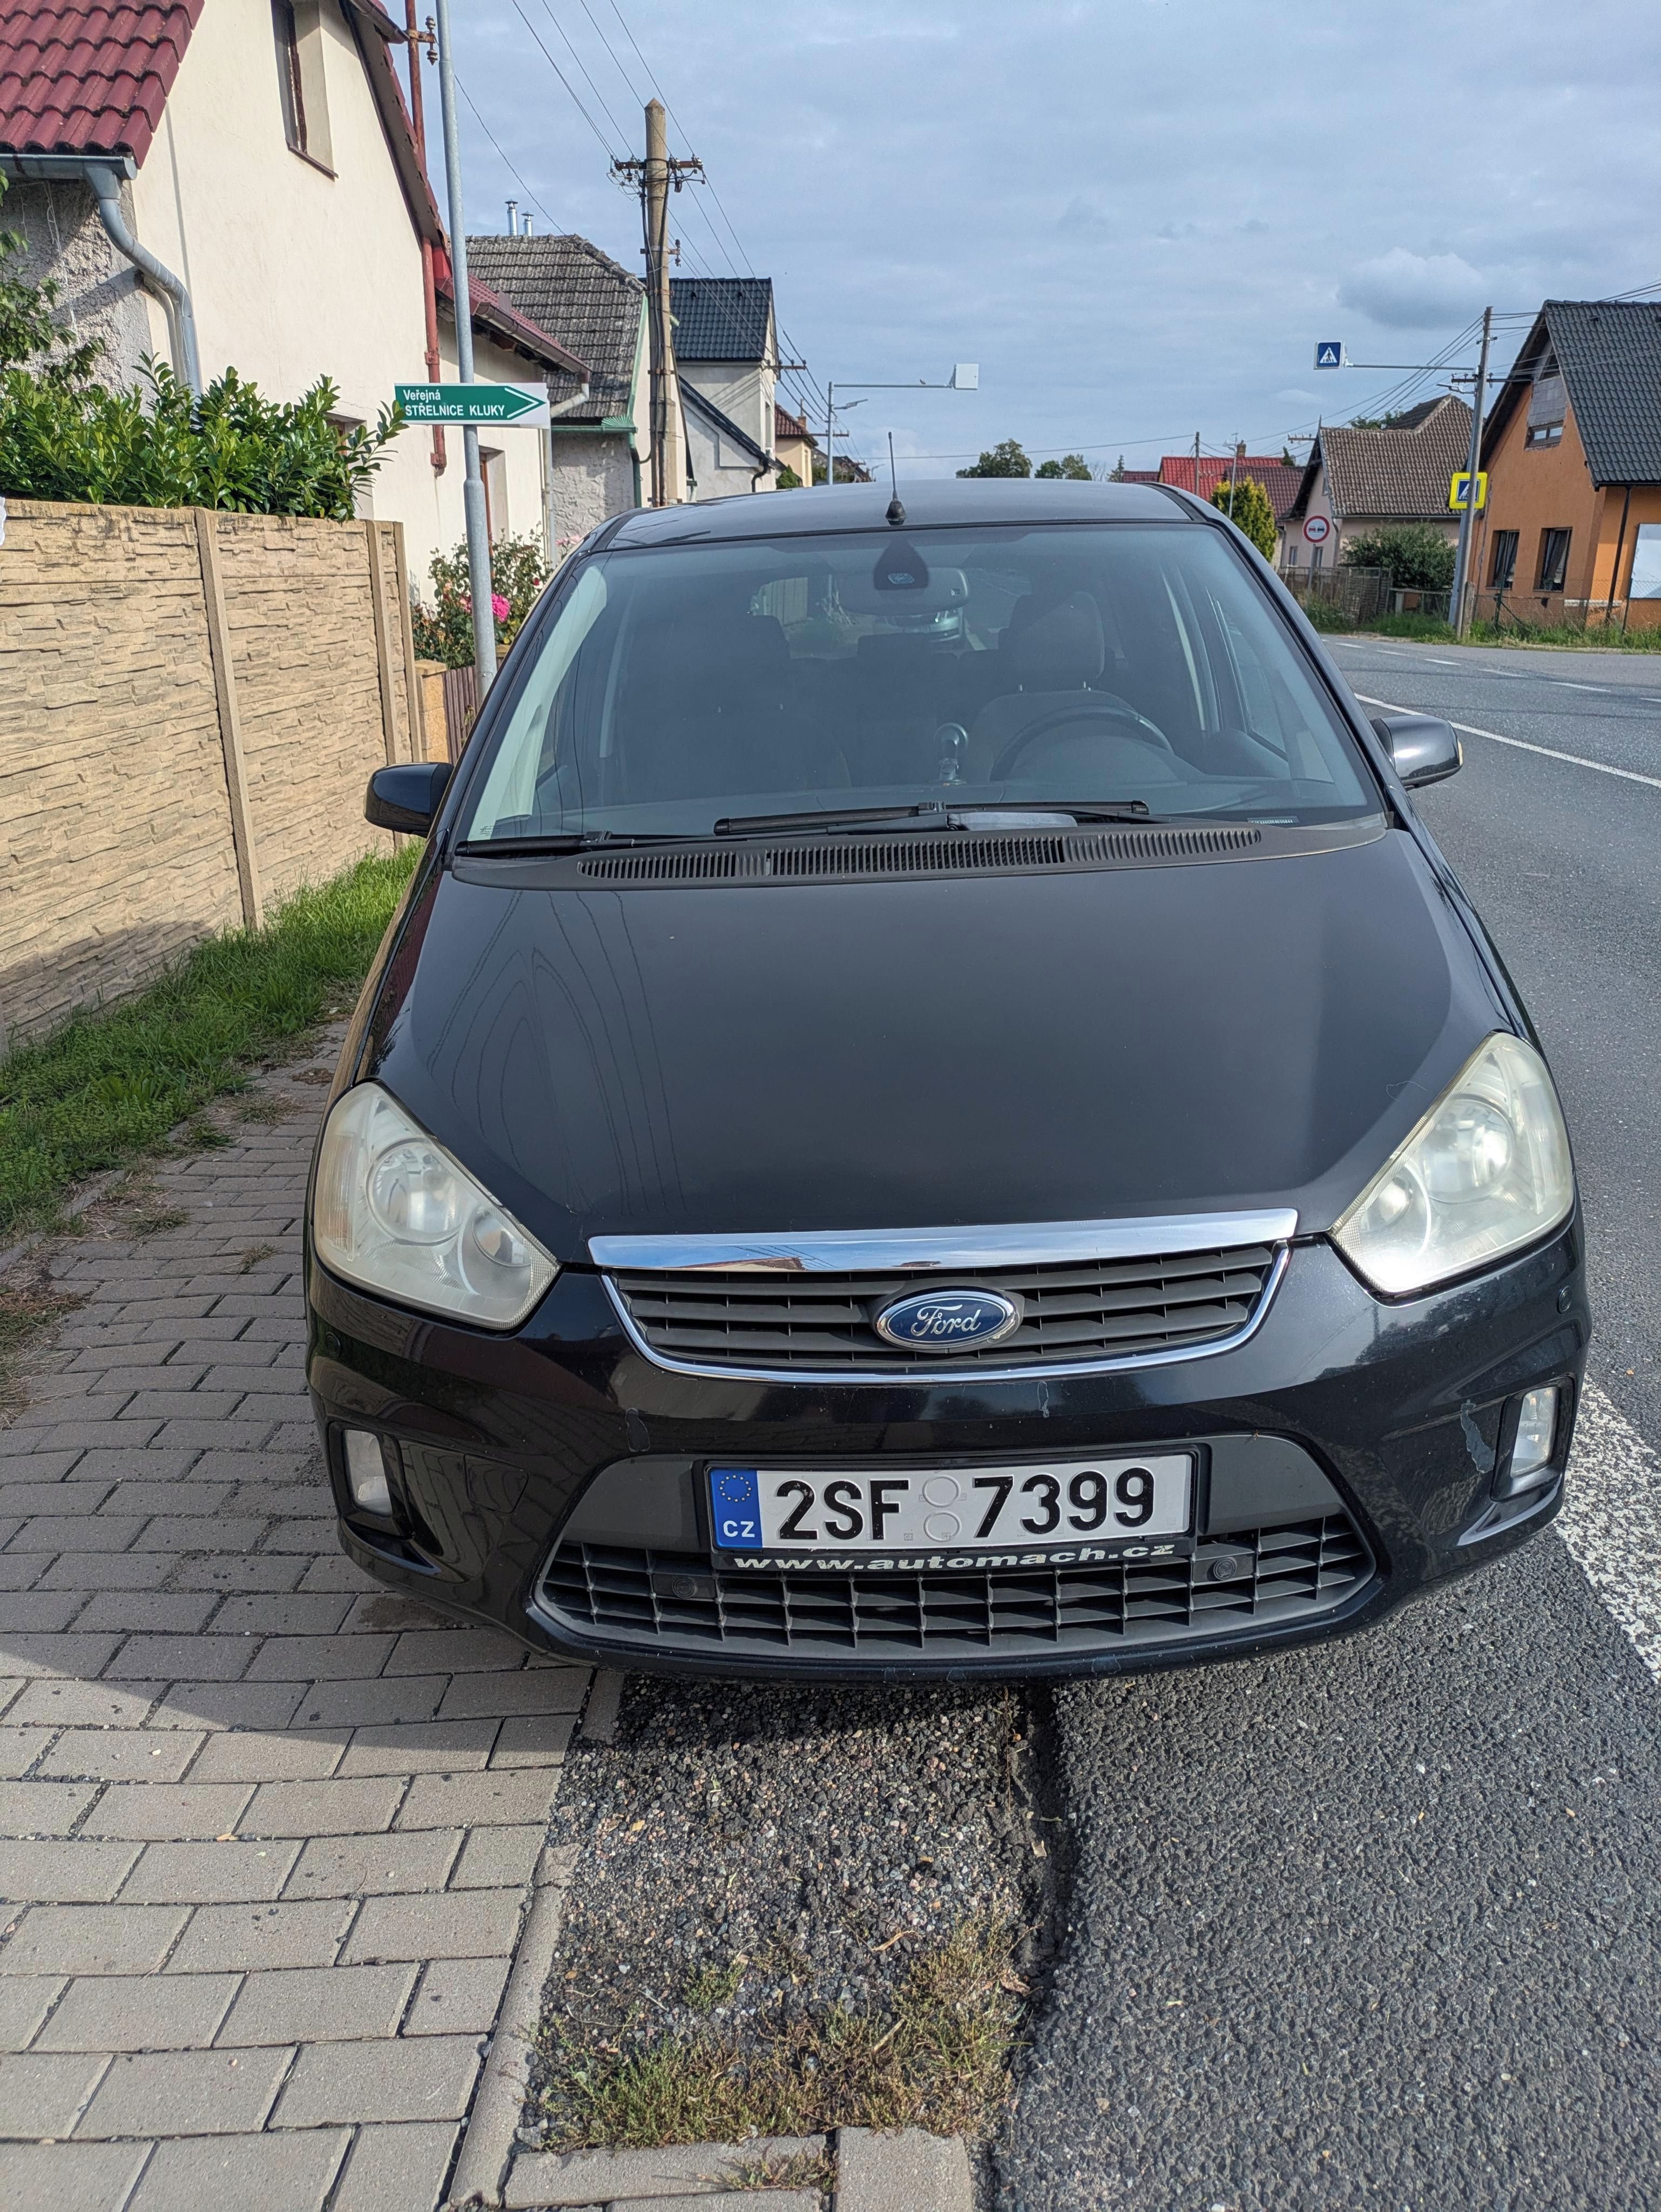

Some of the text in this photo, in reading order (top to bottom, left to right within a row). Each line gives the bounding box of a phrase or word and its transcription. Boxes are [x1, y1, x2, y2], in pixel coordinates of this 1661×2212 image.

[403, 389, 441, 403] Veřejná
[405, 402, 505, 416] STŘELNICE KLUKY
[910, 1304, 981, 1337] Ford
[776, 1467, 1154, 1540] 2SF 7399
[723, 1520, 755, 1538] CZ
[733, 1544, 1175, 1570] www.automach.cz
